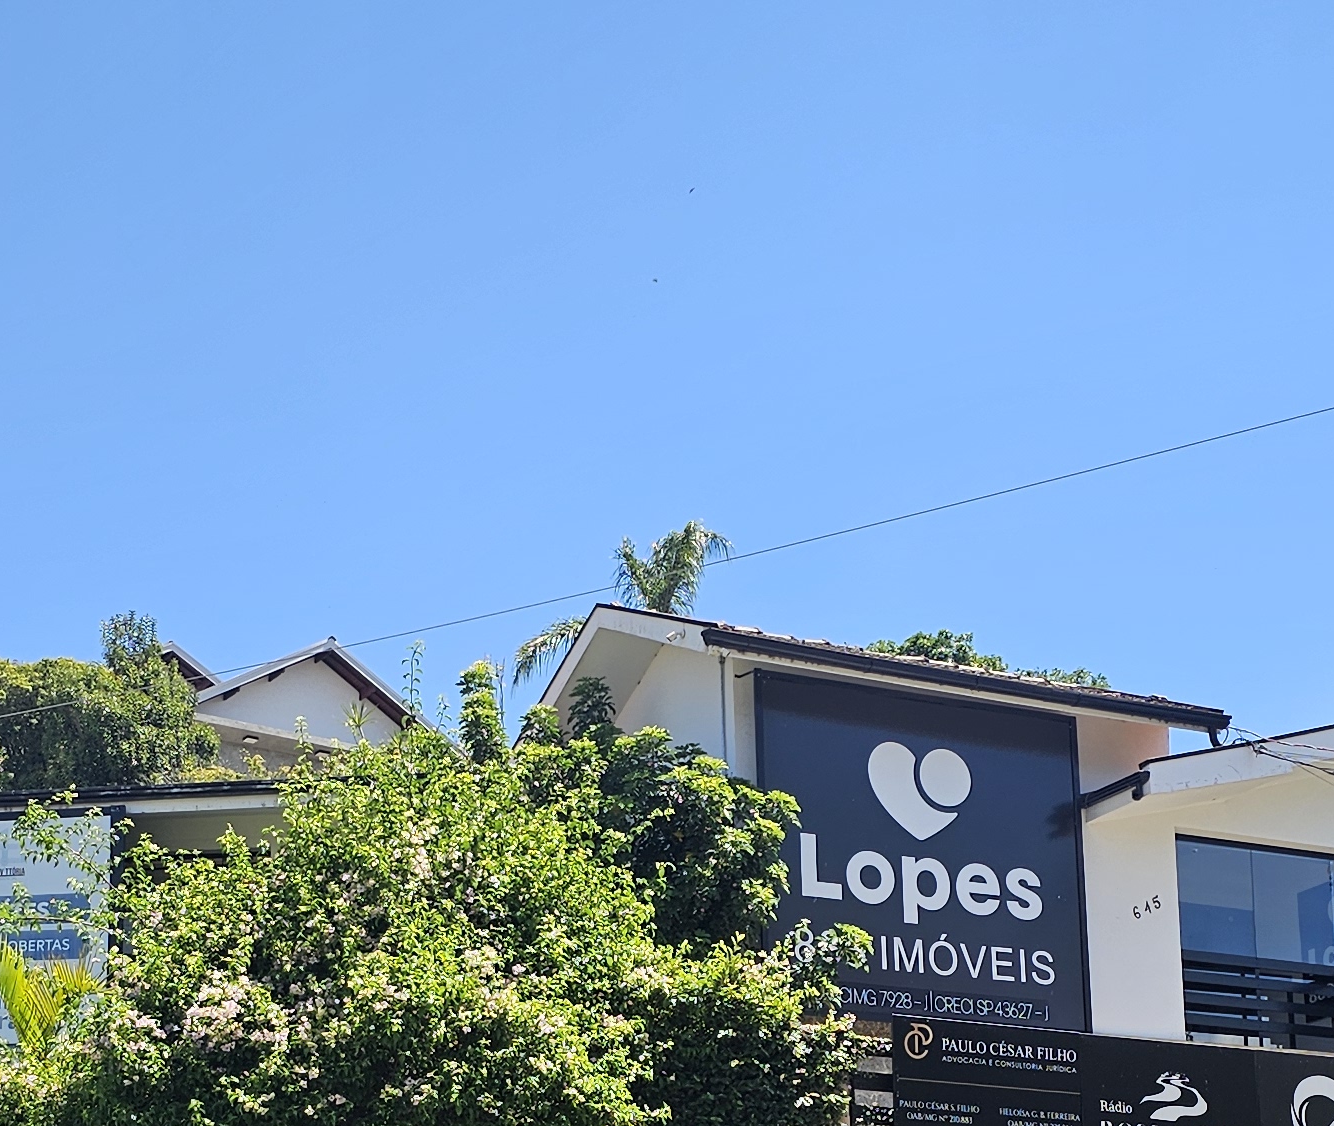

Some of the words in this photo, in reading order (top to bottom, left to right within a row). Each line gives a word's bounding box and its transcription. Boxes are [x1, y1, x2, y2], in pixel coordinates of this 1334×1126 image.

[799, 831, 1043, 925] Lopes
[1132, 894, 1161, 919] 645
[880, 933, 1056, 986] IMÓVEIS
[853, 988, 877, 1007] MG
[880, 989, 913, 1010] 7928
[934, 995, 974, 1015] CRECI
[976, 999, 994, 1016] SP
[994, 1000, 1033, 1020] 43627
[941, 1037, 987, 1055] PAULO
[989, 1040, 1034, 1059] CÉSAR
[1037, 1047, 1077, 1063] FILHO
[941, 1055, 987, 1067] ADVOCACIA
[994, 1060, 1043, 1071] CONSULTORIA
[1045, 1065, 1078, 1074] JURÍDICA
[899, 1099, 925, 1109] PAULO
[925, 1100, 950, 1111] CÉSAR
[957, 1104, 980, 1114] FILHO
[1099, 1099, 1133, 1114] Rádio
